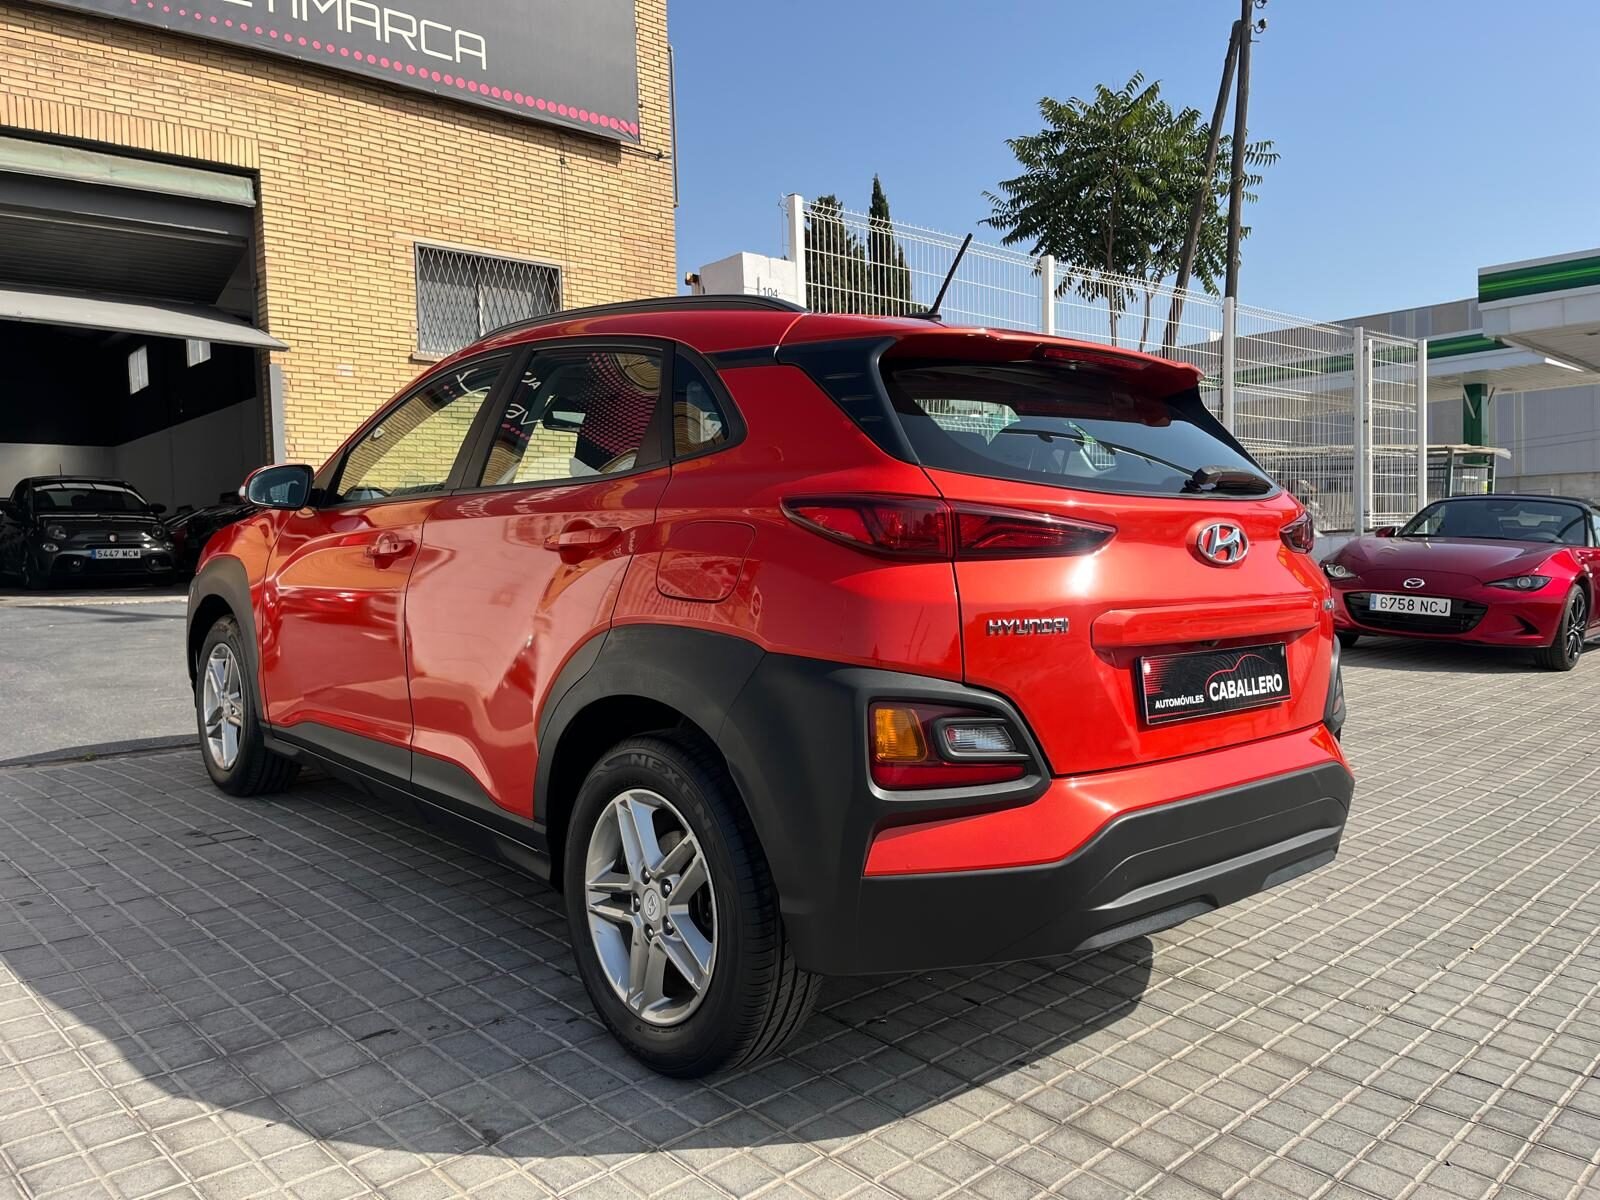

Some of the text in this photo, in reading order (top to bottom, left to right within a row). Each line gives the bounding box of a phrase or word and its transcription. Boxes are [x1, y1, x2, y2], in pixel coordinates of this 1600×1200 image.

[762, 287, 778, 298] 104
[97, 549, 120, 558] 5447
[1380, 597, 1448, 614] 6758 NCJ
[986, 617, 1069, 636] HYUNDAI
[1154, 673, 1283, 710] AUTOMÓVILES CABALLERO
[629, 753, 713, 831] NEXEN
